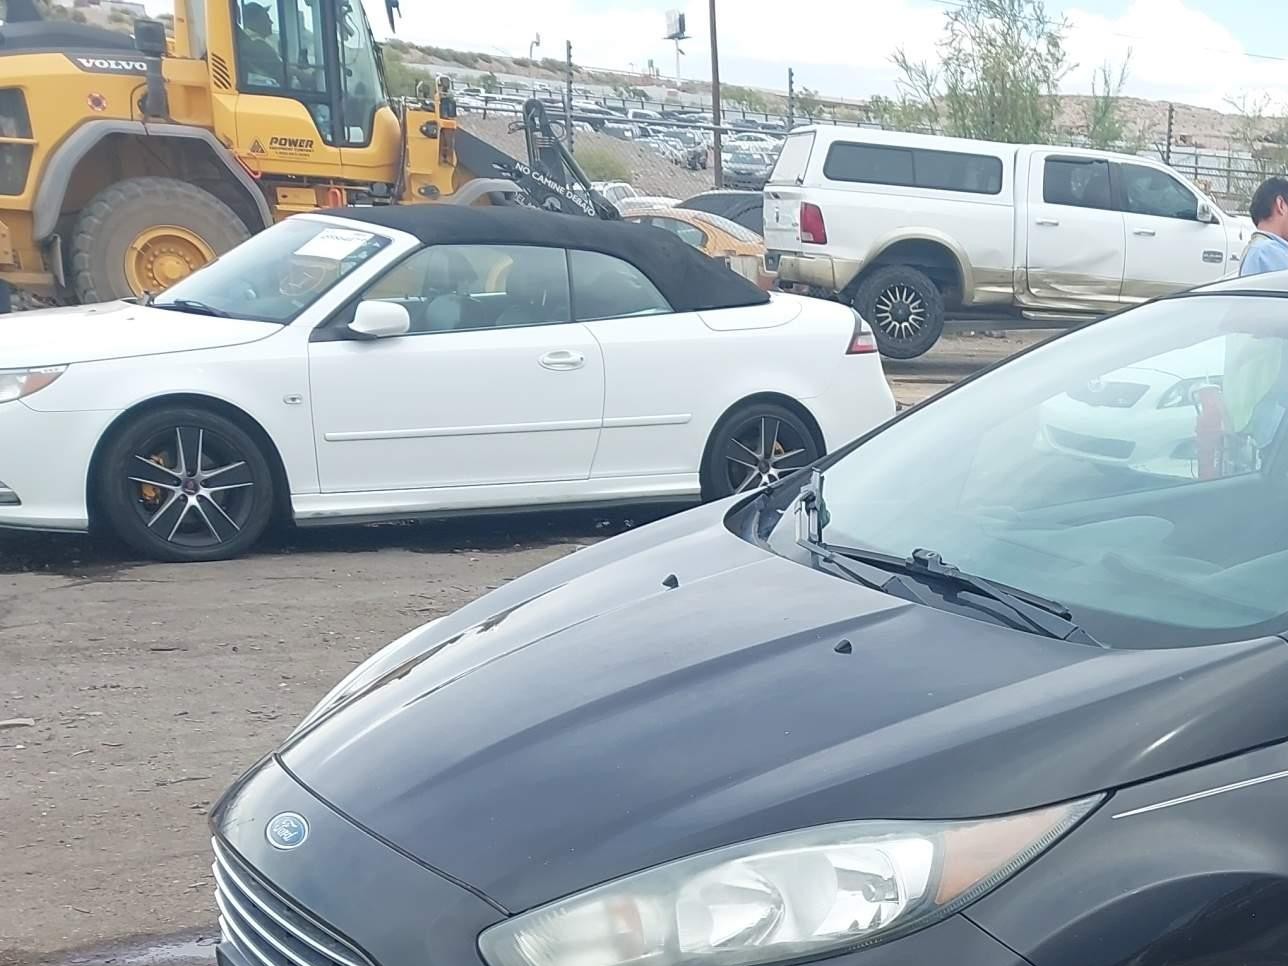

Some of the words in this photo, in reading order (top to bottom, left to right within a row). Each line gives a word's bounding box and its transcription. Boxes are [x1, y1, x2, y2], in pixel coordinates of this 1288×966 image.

[77, 58, 147, 71] VOLVO
[269, 136, 314, 149] POWER
[515, 162, 531, 175] NO
[531, 171, 566, 194] CAMINE
[565, 190, 596, 217] DEBAJO
[272, 818, 299, 841] Ford
